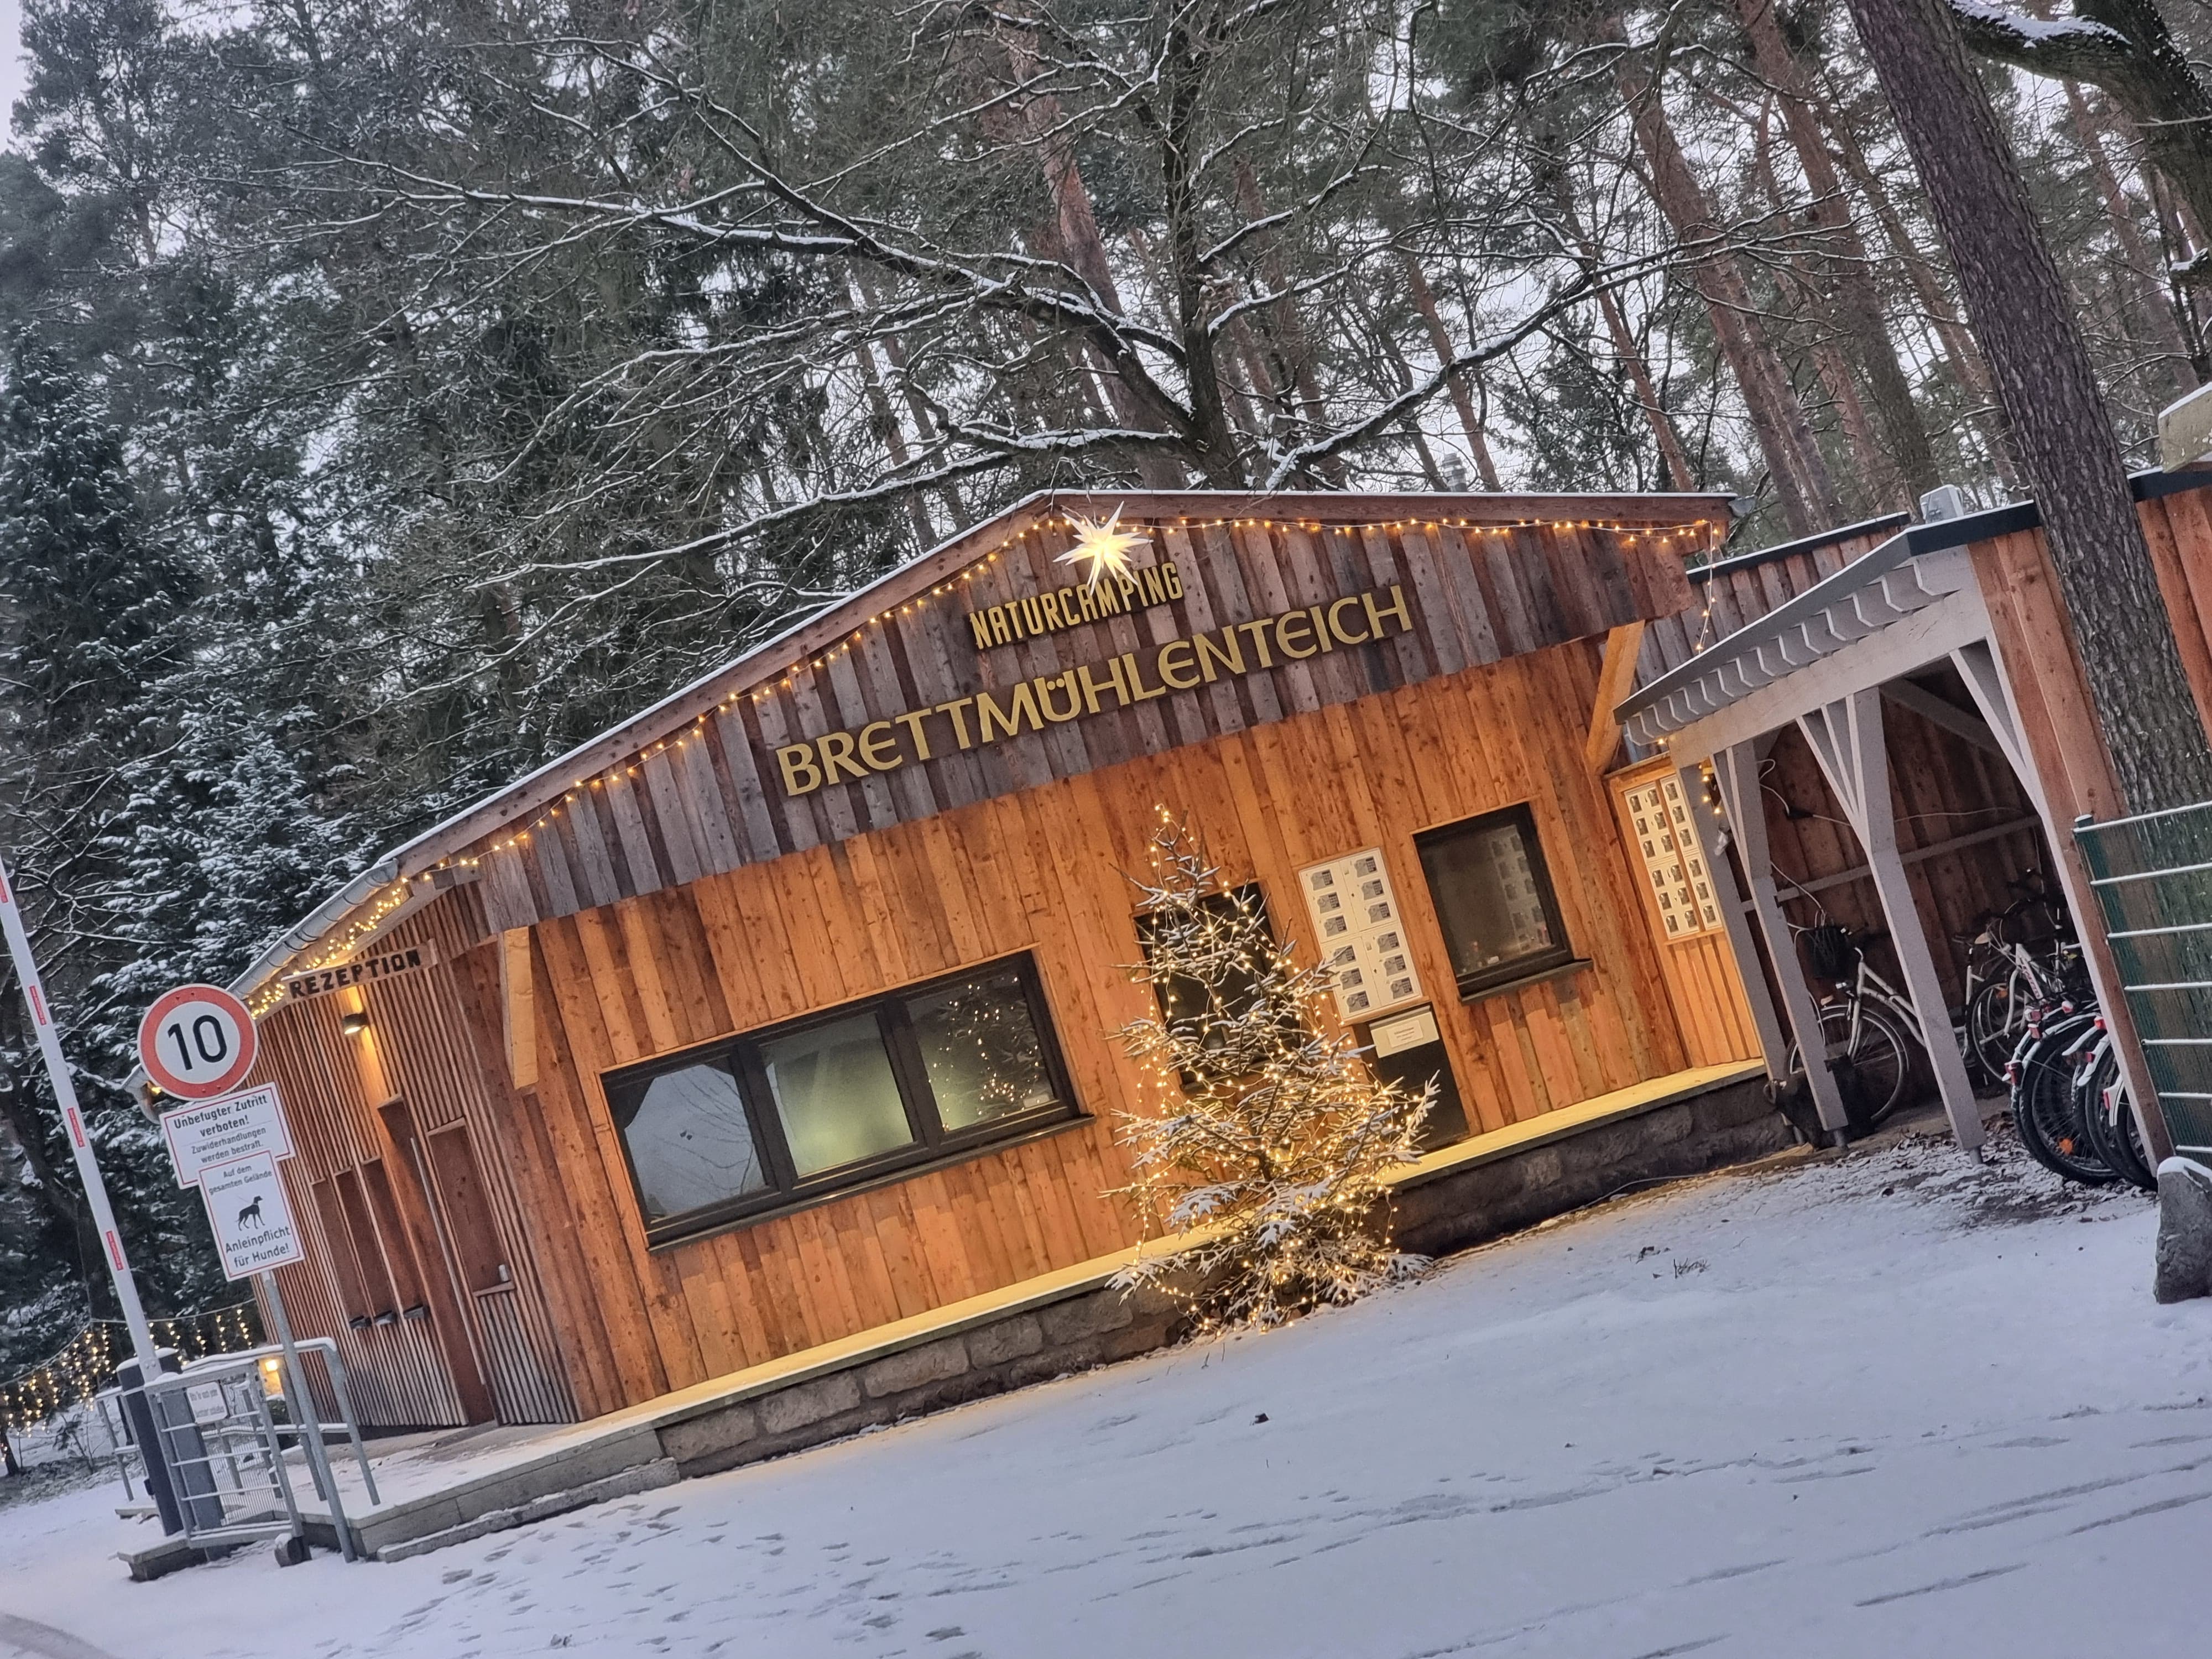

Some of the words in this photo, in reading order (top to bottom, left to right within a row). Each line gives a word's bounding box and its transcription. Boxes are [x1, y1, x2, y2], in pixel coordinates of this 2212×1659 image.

[969, 561, 1183, 650] NATURCAMPING
[776, 585, 1413, 796] BRETTMÜHLENTEICH
[289, 949, 421, 999] REZEPTION
[167, 1015, 227, 1071] 10
[174, 1106, 231, 1129] Unbefugter
[234, 1094, 268, 1112] Zutritt
[200, 1115, 249, 1137] verboten!
[191, 1127, 266, 1154] Zuwiderhandlungen
[201, 1147, 229, 1163] werden
[231, 1140, 263, 1155] bestraft.
[208, 1179, 242, 1196] gesamten
[244, 1170, 273, 1183] Gelände
[223, 1168, 235, 1178] Auf
[237, 1165, 252, 1174] dem
[226, 1226, 290, 1254] Anleinpflicht
[234, 1255, 250, 1267] für
[252, 1243, 289, 1262] Hunde!
